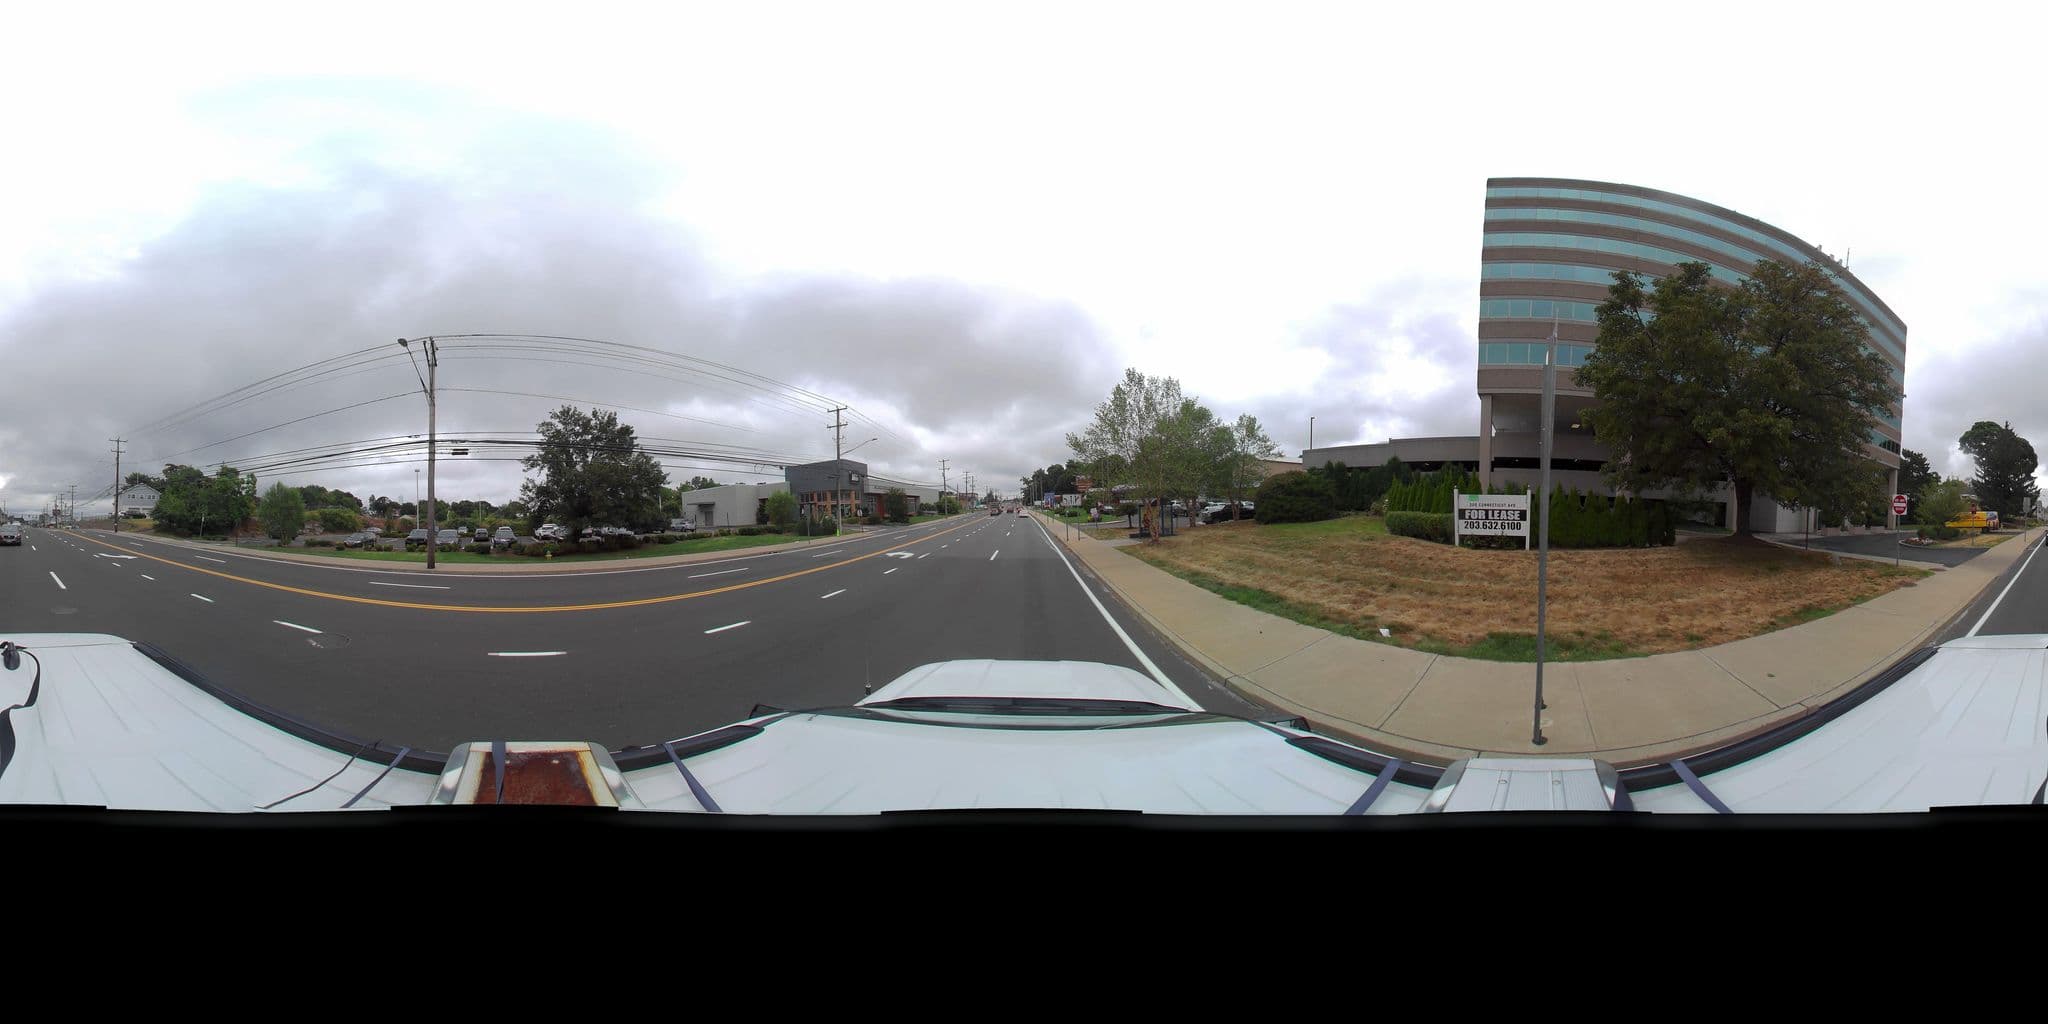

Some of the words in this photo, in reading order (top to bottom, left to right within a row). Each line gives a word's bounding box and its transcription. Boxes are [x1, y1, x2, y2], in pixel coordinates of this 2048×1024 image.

[1465, 510, 1486, 519] FOR
[1488, 510, 1520, 520] LEASE
[1464, 521, 1521, 530] 203.632.6100
